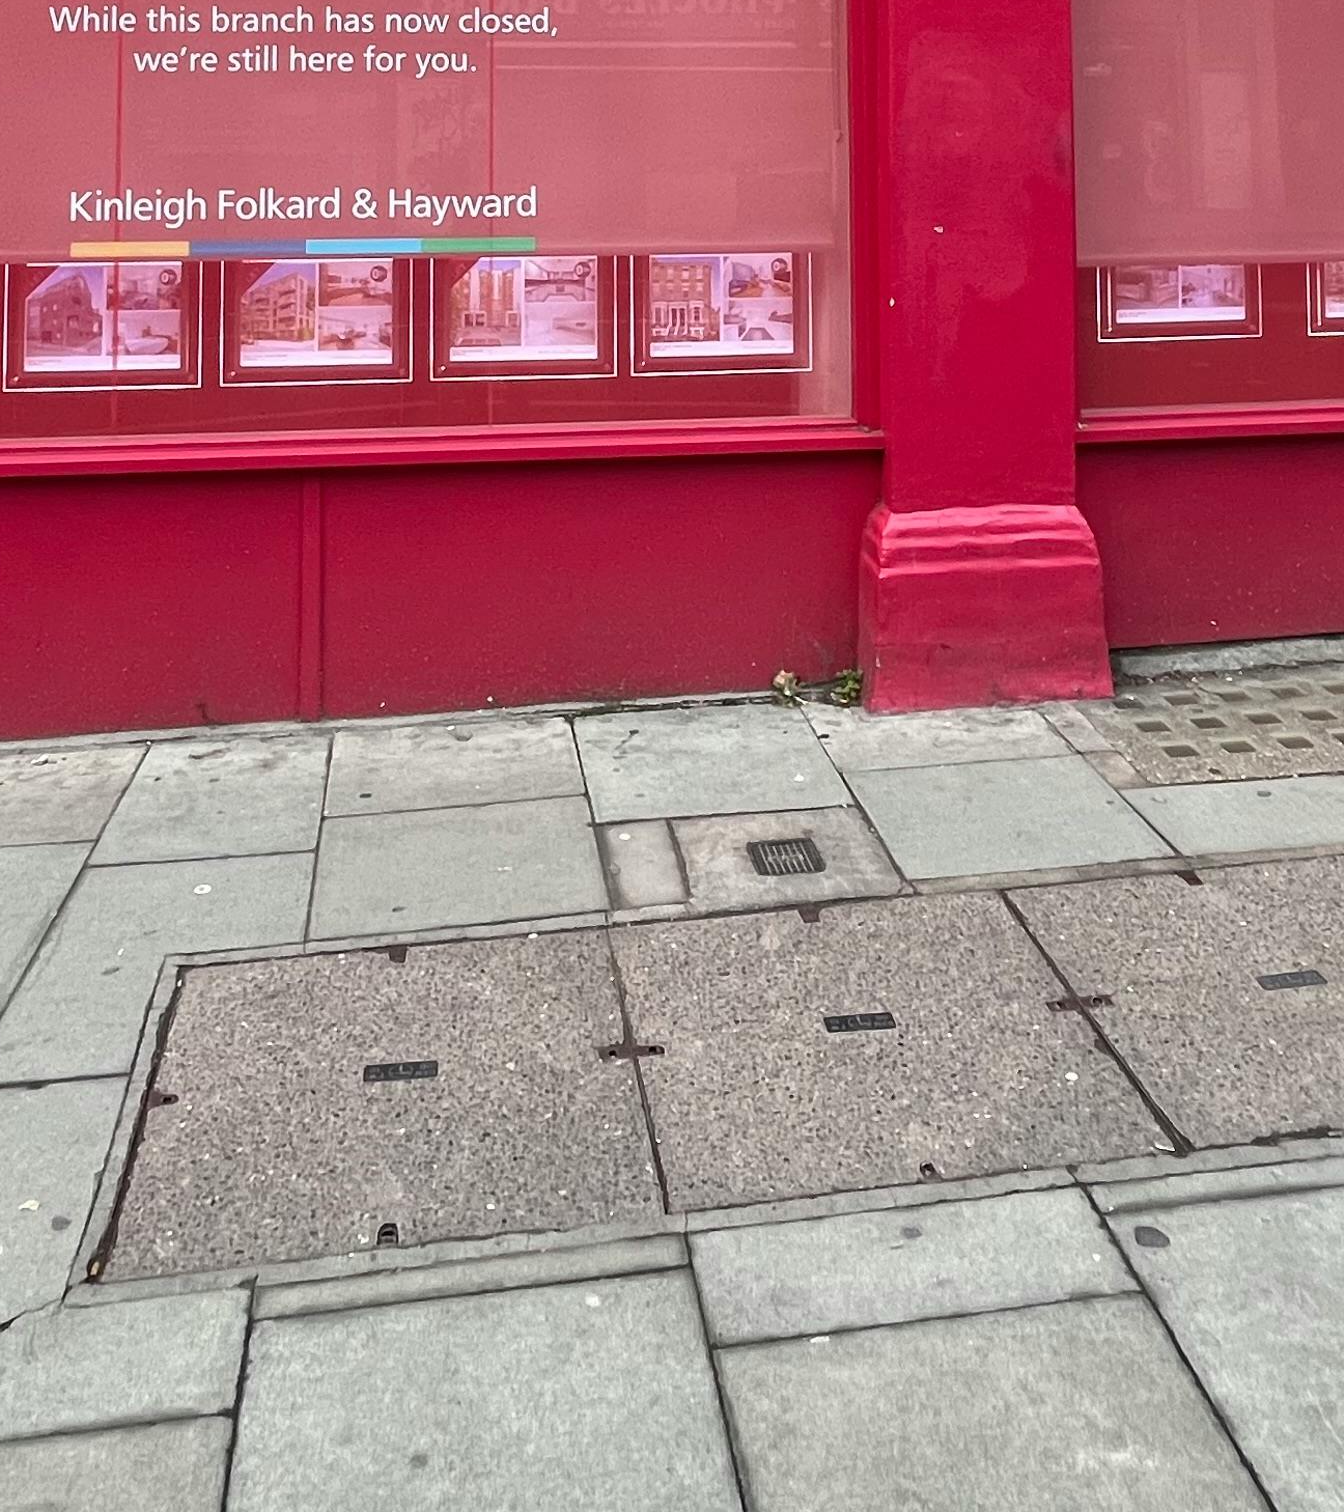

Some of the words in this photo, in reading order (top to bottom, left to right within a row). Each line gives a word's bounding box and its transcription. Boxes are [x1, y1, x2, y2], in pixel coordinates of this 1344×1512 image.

[48, 4, 137, 33] While
[145, 5, 201, 33] this
[212, 5, 313, 33] branch
[325, 5, 374, 33] has
[385, 13, 450, 33] now
[458, 6, 558, 37] closed,
[133, 46, 218, 73] we're
[227, 44, 278, 72] still
[289, 45, 354, 72] here
[362, 44, 407, 72] for
[415, 52, 477, 79] you.
[70, 188, 207, 229] Kinleigh
[218, 187, 340, 220] Folkard
[351, 188, 378, 219] &
[388, 185, 537, 226] Hayward
